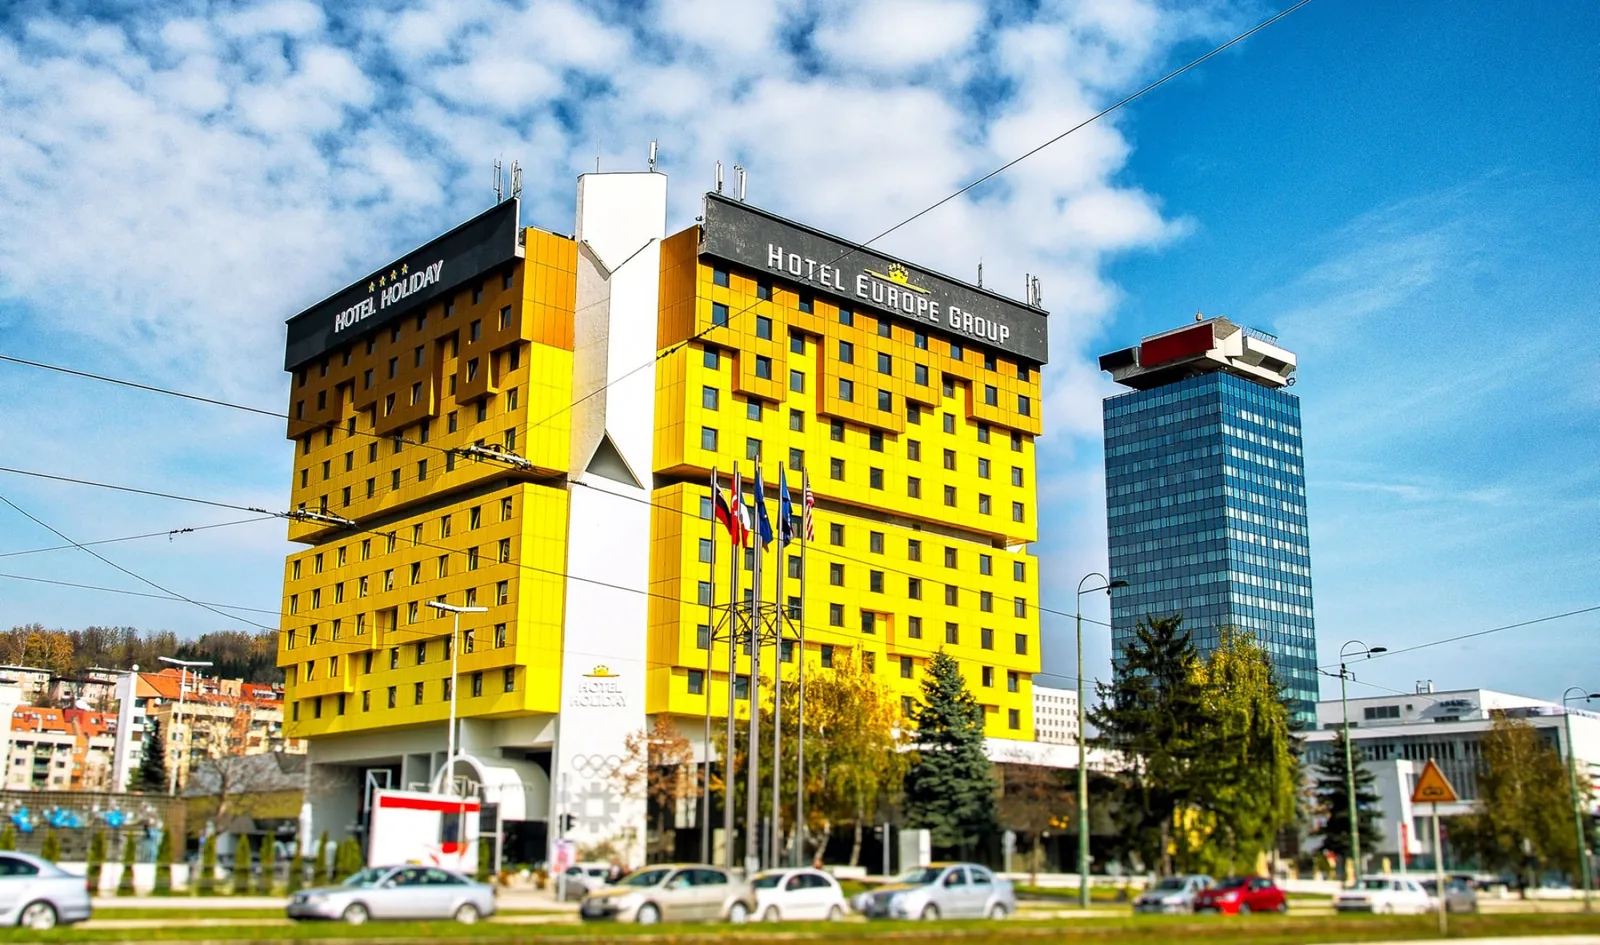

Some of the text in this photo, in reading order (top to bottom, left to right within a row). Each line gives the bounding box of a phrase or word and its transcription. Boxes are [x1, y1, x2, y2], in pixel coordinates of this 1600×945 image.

[334, 259, 444, 333] HOTEL HOLIDAY
[768, 243, 1011, 344] HOTEL EUROPE GROUP
[568, 695, 628, 708] HOLIDAY
[578, 681, 623, 694] HOTEL
